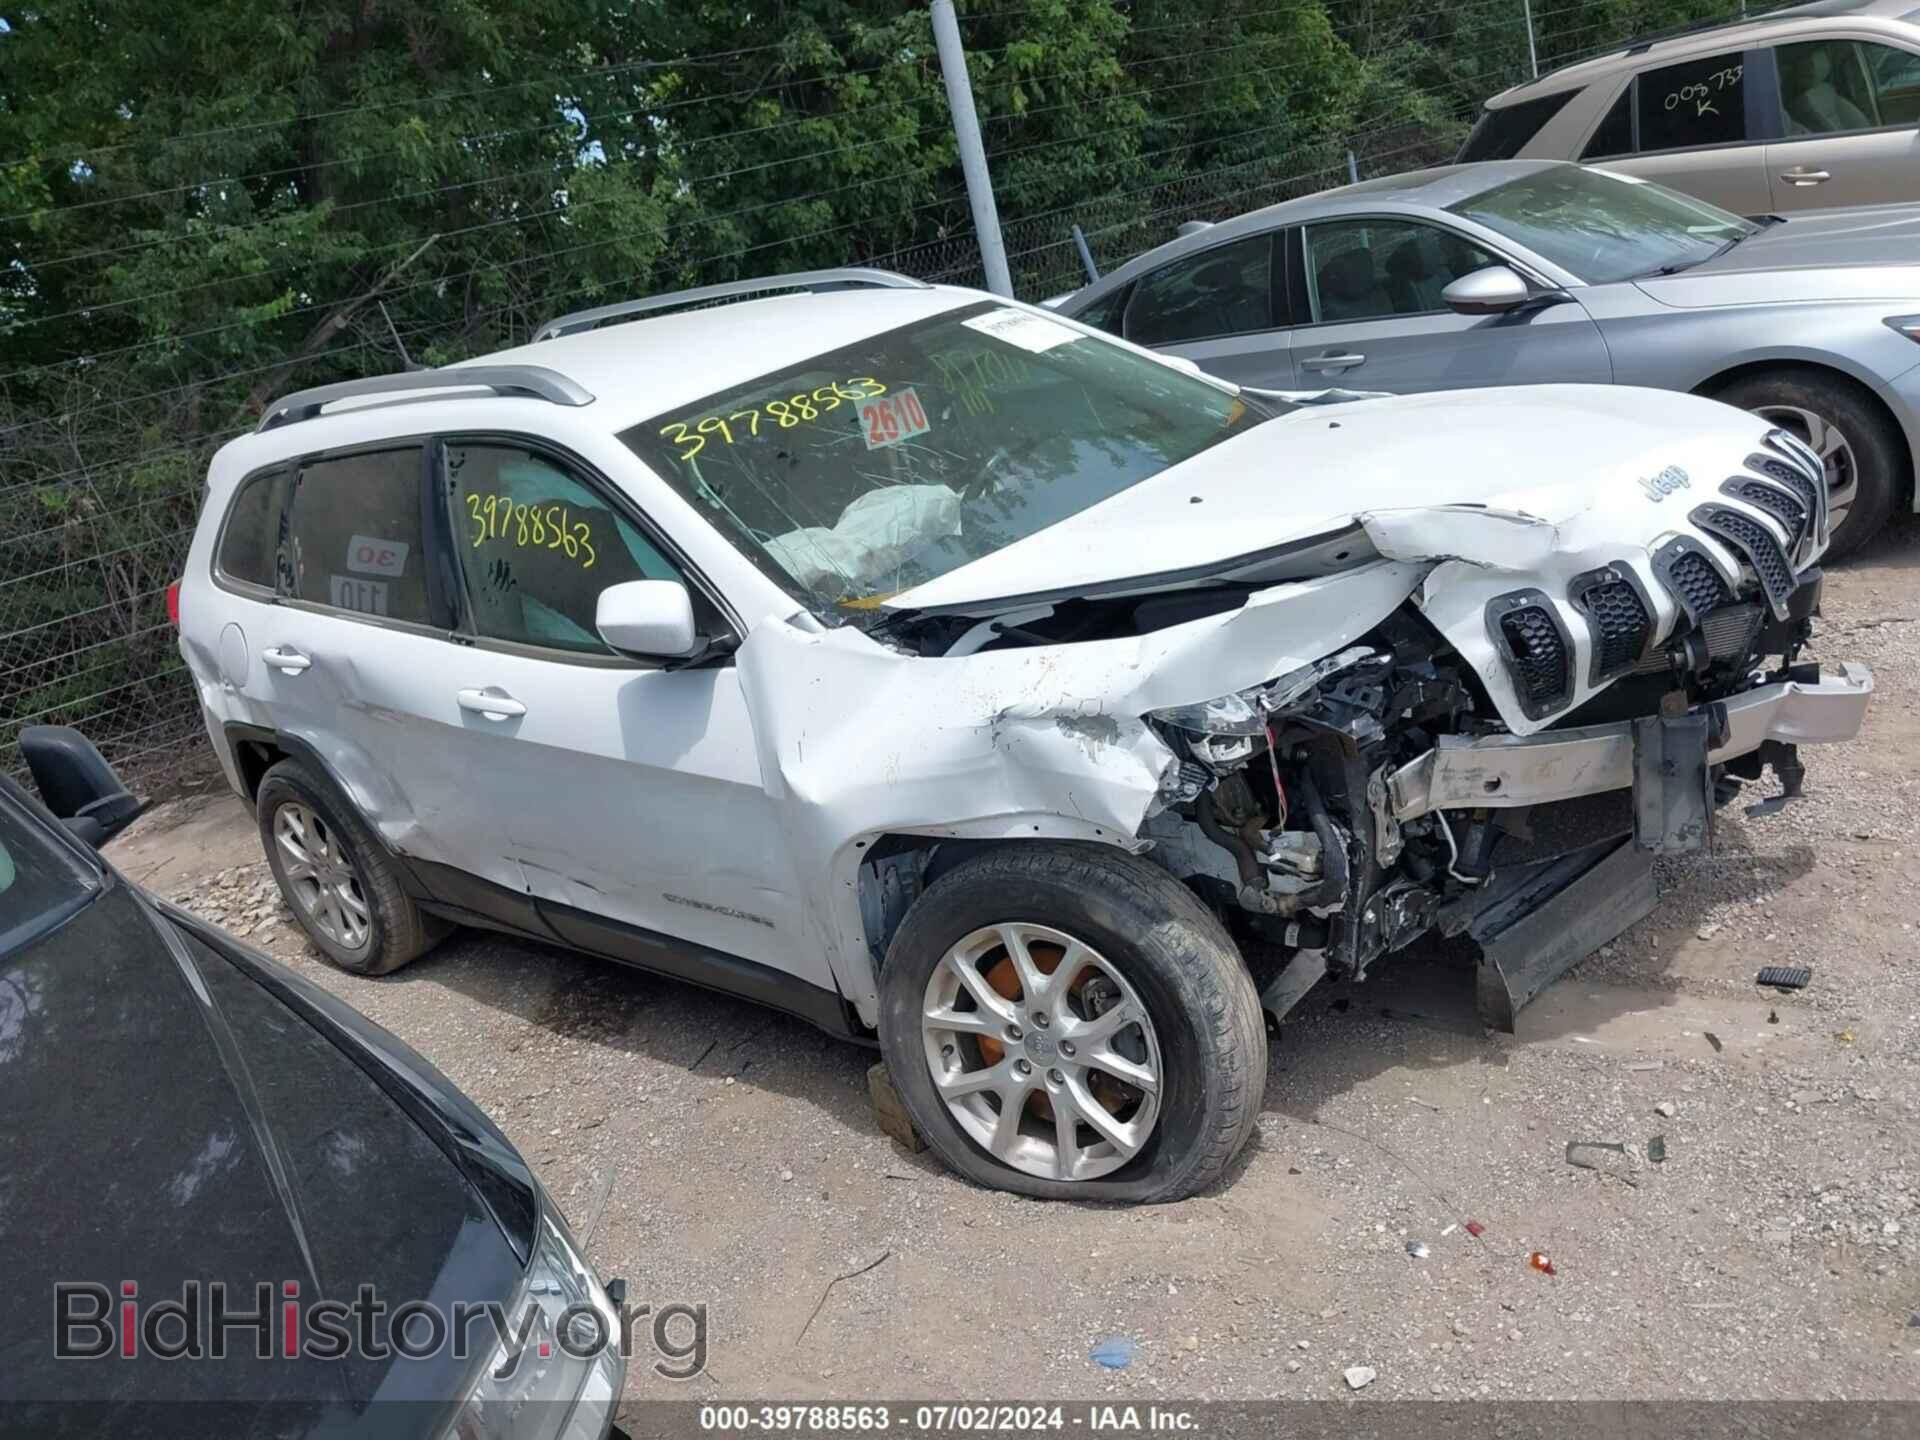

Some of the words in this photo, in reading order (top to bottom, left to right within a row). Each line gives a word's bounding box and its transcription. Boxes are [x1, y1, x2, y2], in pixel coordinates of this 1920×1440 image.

[1696, 99, 1719, 117] K
[659, 377, 887, 460] 39788563
[863, 393, 926, 442] 2610
[1638, 464, 1691, 503] Jeep
[466, 494, 596, 568] 39788563
